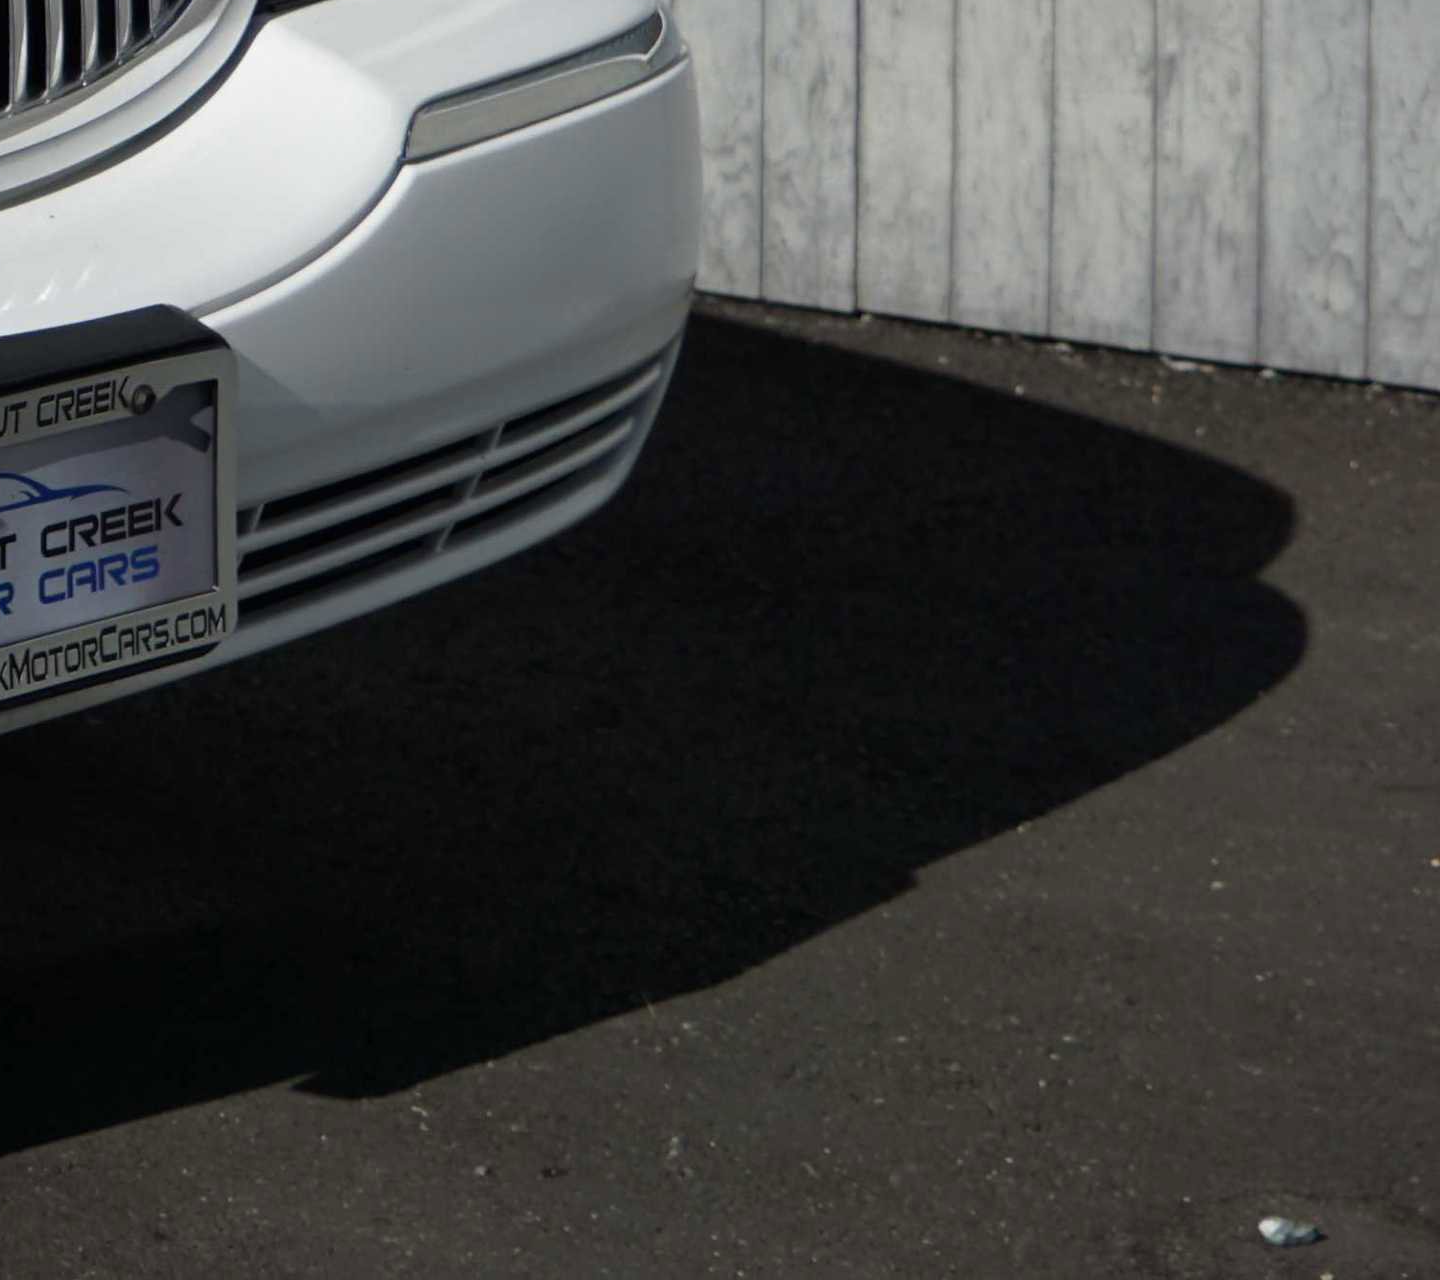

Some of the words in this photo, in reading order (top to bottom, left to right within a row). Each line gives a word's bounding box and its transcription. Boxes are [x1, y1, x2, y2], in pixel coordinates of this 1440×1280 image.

[36, 375, 133, 427] CREEK
[39, 492, 184, 559] CREEK
[38, 545, 160, 606] CARS
